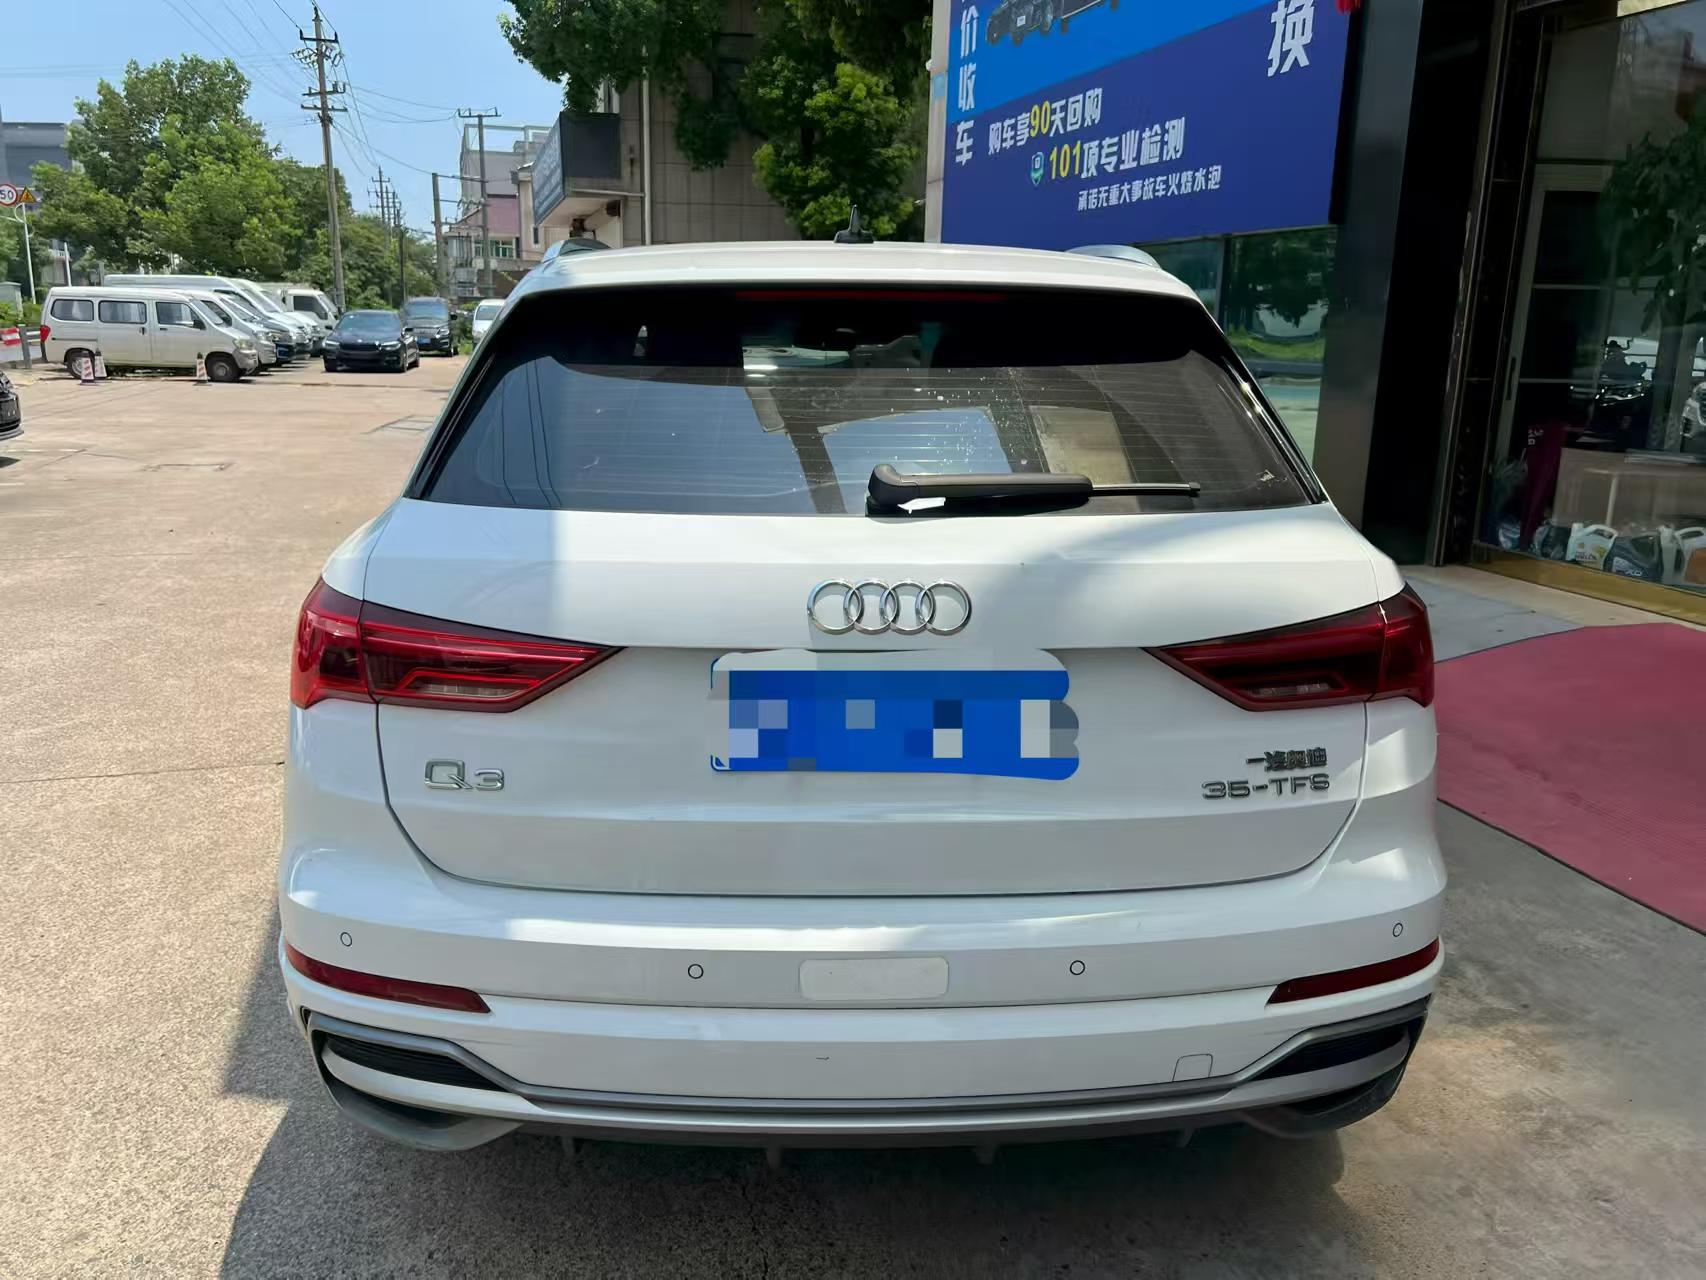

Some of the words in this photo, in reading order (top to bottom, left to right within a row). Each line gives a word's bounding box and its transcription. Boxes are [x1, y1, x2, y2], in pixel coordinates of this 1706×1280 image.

[1267, 0, 1315, 77] 换
[955, 0, 979, 166] 价收车
[988, 88, 1103, 155] 购车享90天回购
[1049, 117, 1185, 180] 101项专业检测
[1077, 165, 1222, 211] 承诺无重大事故车火烧水泡
[424, 760, 505, 791] Q3
